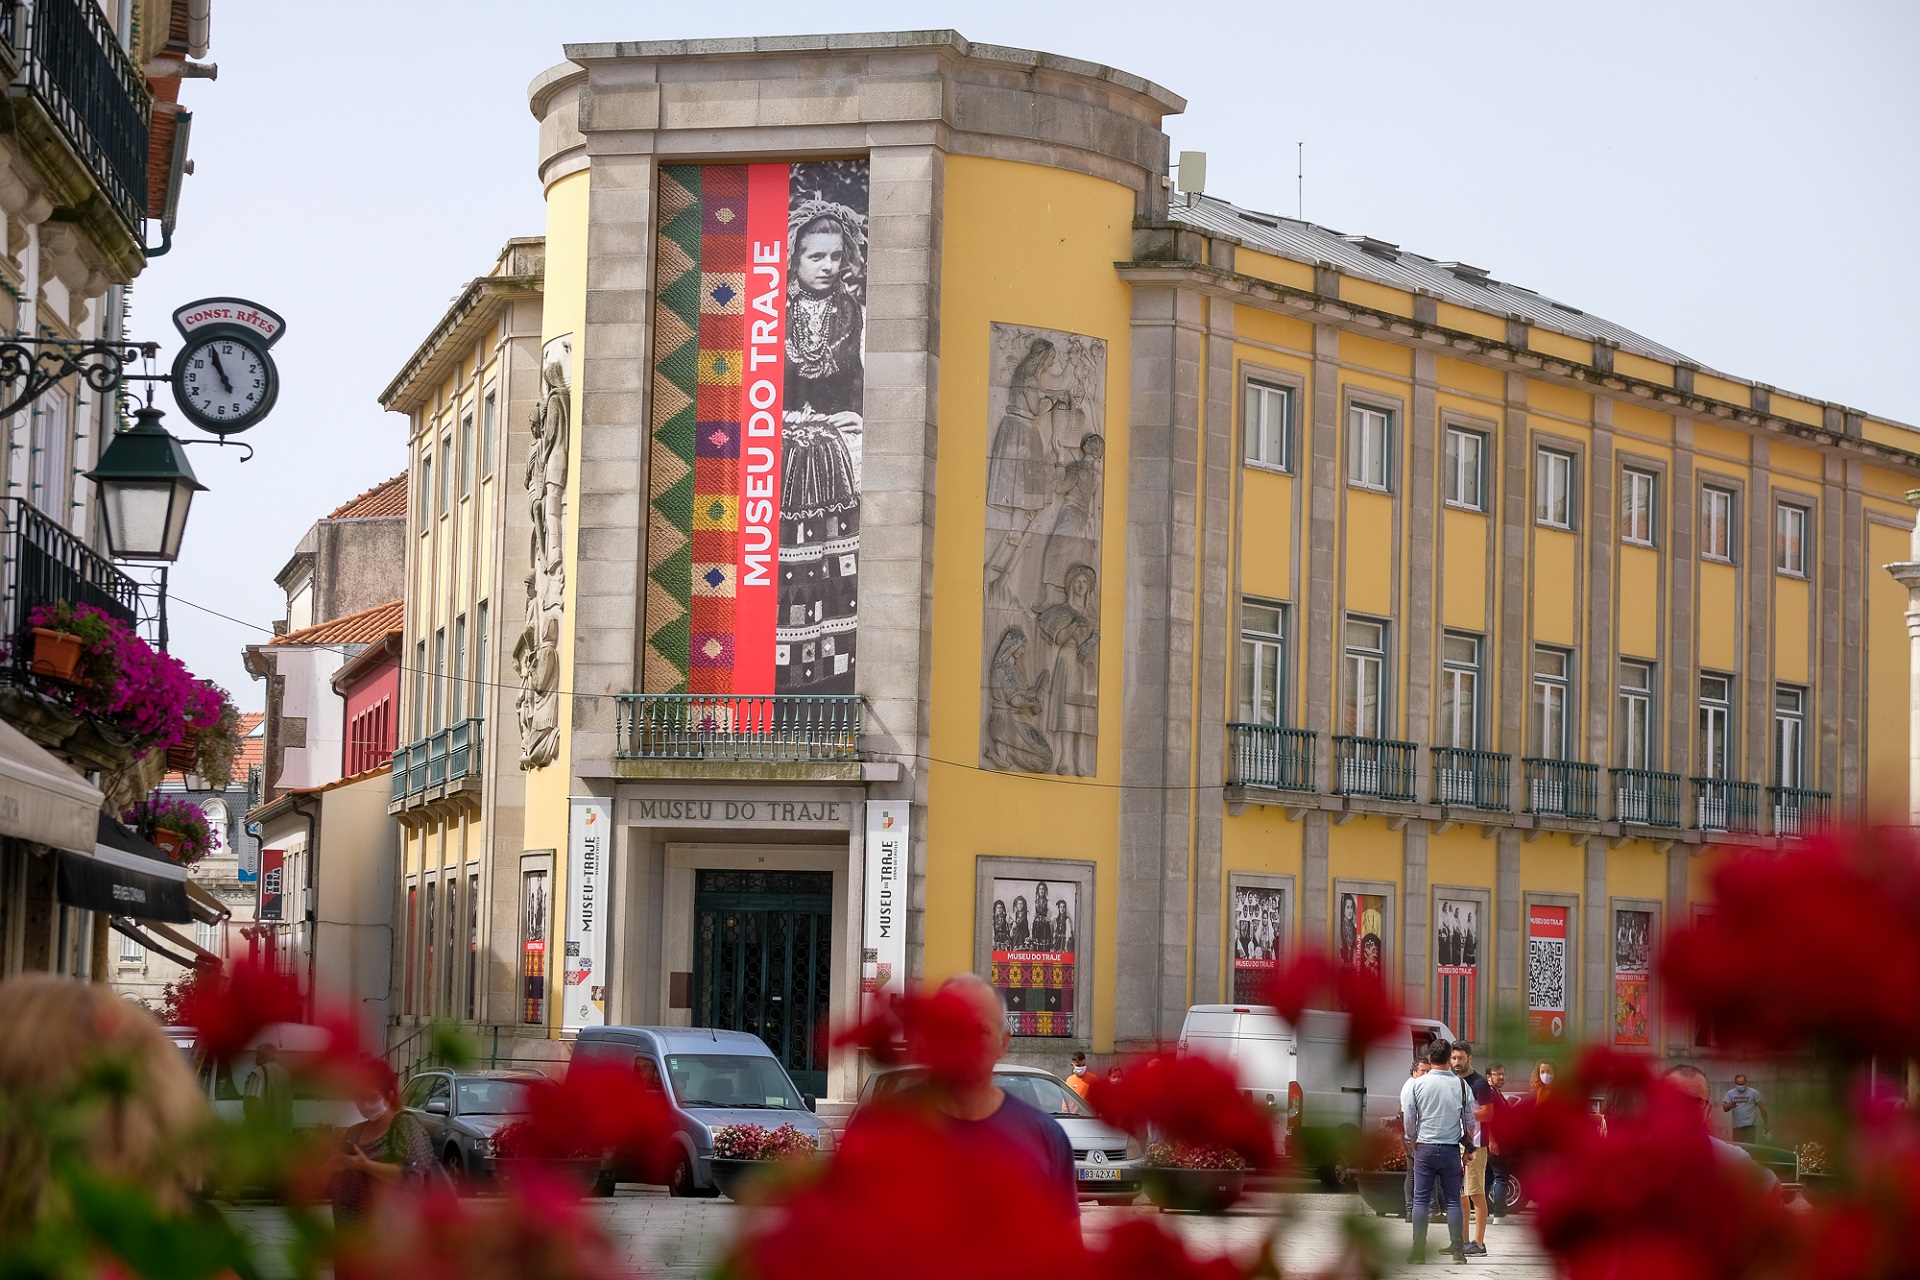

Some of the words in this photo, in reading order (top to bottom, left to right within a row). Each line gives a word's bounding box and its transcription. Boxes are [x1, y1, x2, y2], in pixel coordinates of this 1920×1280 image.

[749, 240, 780, 371] TRAJE
[185, 309, 232, 325] CONST.
[222, 345, 233, 355] 12
[194, 359, 204, 369] 10
[249, 364, 257, 374] 2
[189, 372, 197, 382] 9
[253, 378, 260, 389] 3
[246, 392, 254, 402] 4
[203, 399, 212, 410] 7
[217, 405, 225, 415] 6
[232, 402, 240, 413] 5
[747, 379, 776, 438] DO
[743, 448, 774, 586] MUSEU
[640, 801, 712, 820] MUSEU
[724, 802, 756, 820] DO
[767, 803, 840, 821] TRAJE
[583, 836, 595, 877] TRAJE
[881, 840, 893, 882] TRAJE
[582, 884, 594, 932] MUSEU
[880, 890, 891, 938] MUSEU
[1550, 918, 1564, 926] TRAJE
[1042, 953, 1062, 961] TRAJE
